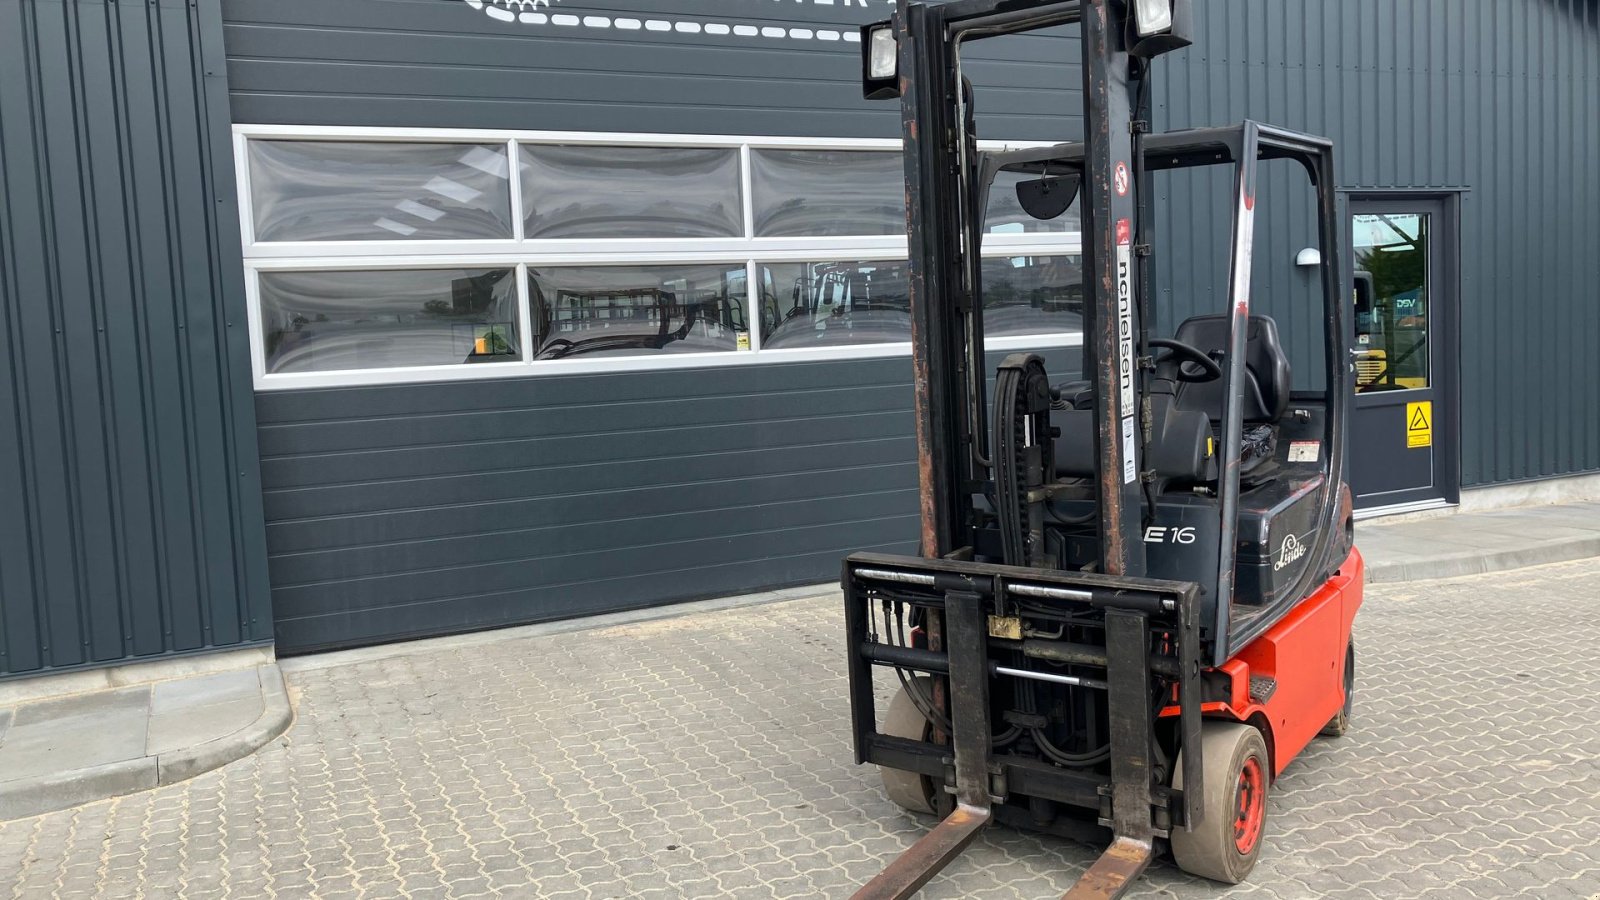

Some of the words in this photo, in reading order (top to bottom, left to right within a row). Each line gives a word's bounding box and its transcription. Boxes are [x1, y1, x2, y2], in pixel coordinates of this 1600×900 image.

[1397, 299, 1415, 307] DSV
[1119, 261, 1131, 390] ncnielsen
[1143, 526, 1167, 543] E
[1171, 526, 1196, 544] 16
[1274, 534, 1306, 571] Linde
